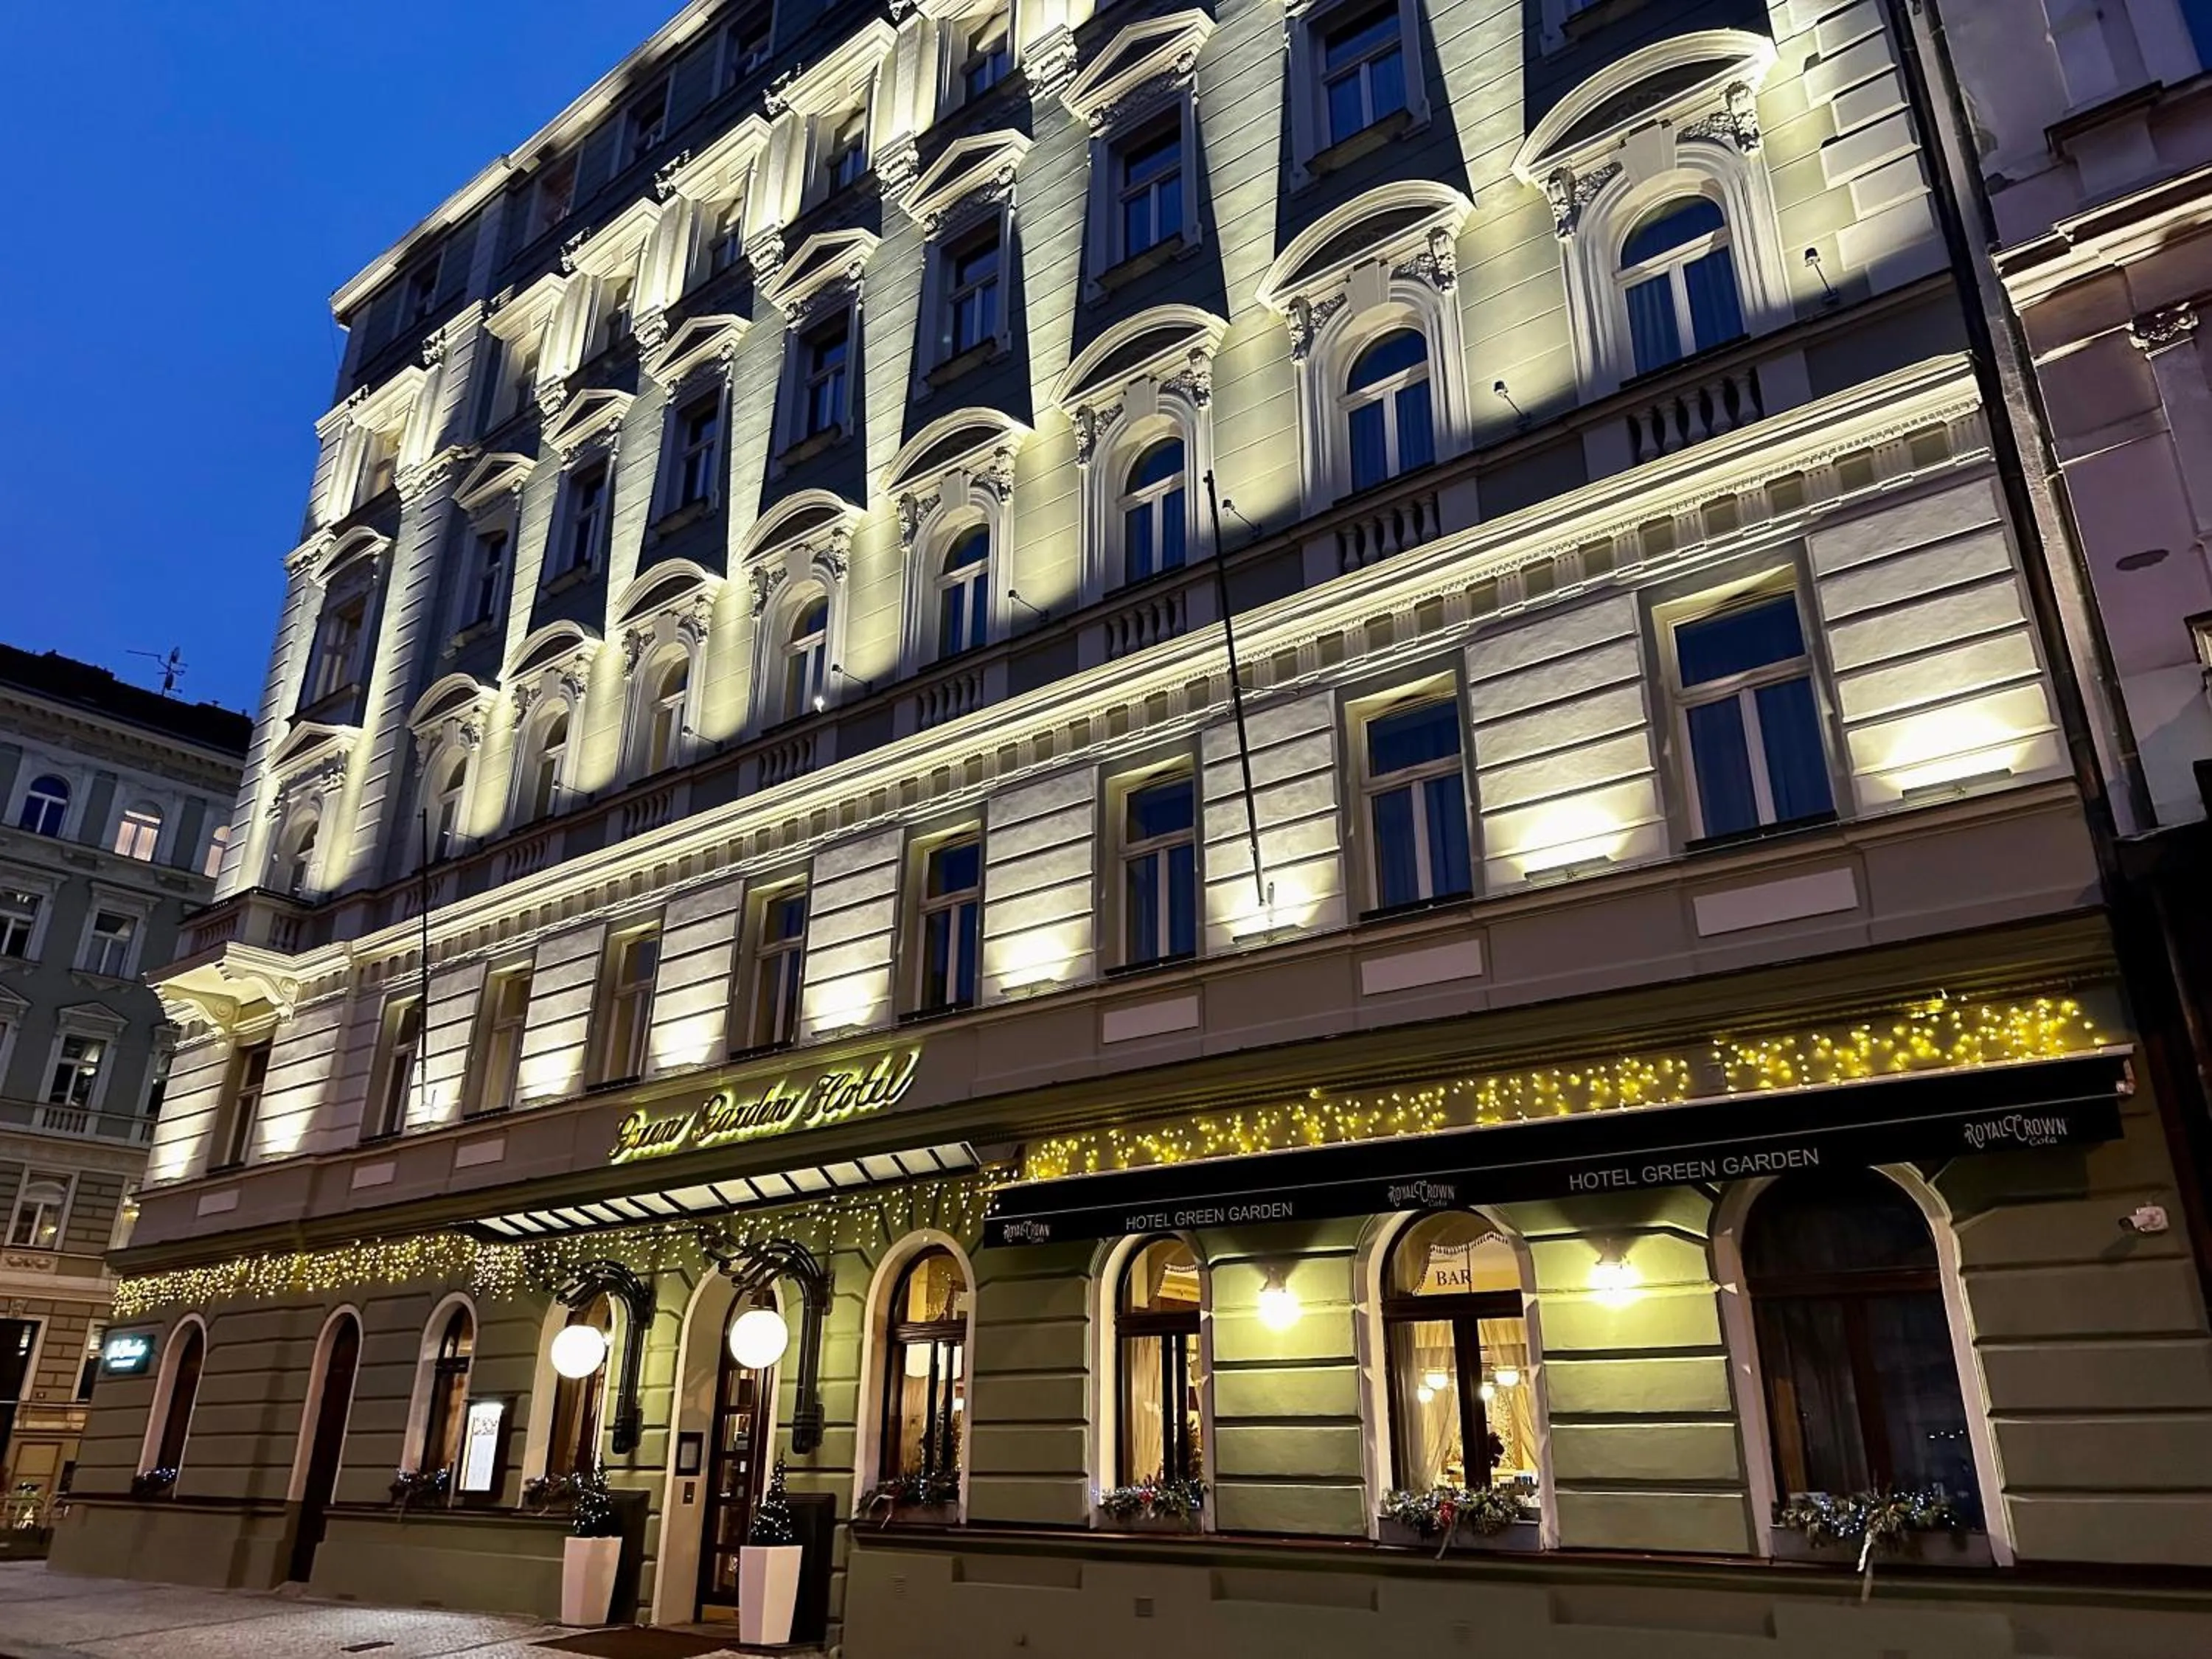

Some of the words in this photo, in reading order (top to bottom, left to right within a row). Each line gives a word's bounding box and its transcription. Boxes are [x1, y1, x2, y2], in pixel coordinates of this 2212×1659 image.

[608, 1110, 698, 1164] Green
[692, 1079, 810, 1147] Garden
[803, 1046, 922, 1124] Hotel
[1964, 1120, 2009, 1149] ROYAL
[2003, 1114, 2067, 1141] CROWN
[1569, 1169, 1637, 1191] HOTEL
[1642, 1159, 1716, 1183] GREEN
[1722, 1147, 1819, 1175] GARDEN
[1388, 1183, 1416, 1207] ROYAL
[1414, 1180, 1455, 1203] CROWN
[1126, 1213, 1171, 1231] HOTEL
[1175, 1208, 1225, 1226] GREEN
[1228, 1202, 1293, 1221] GARDEN
[1436, 1269, 1472, 1286] BAR
